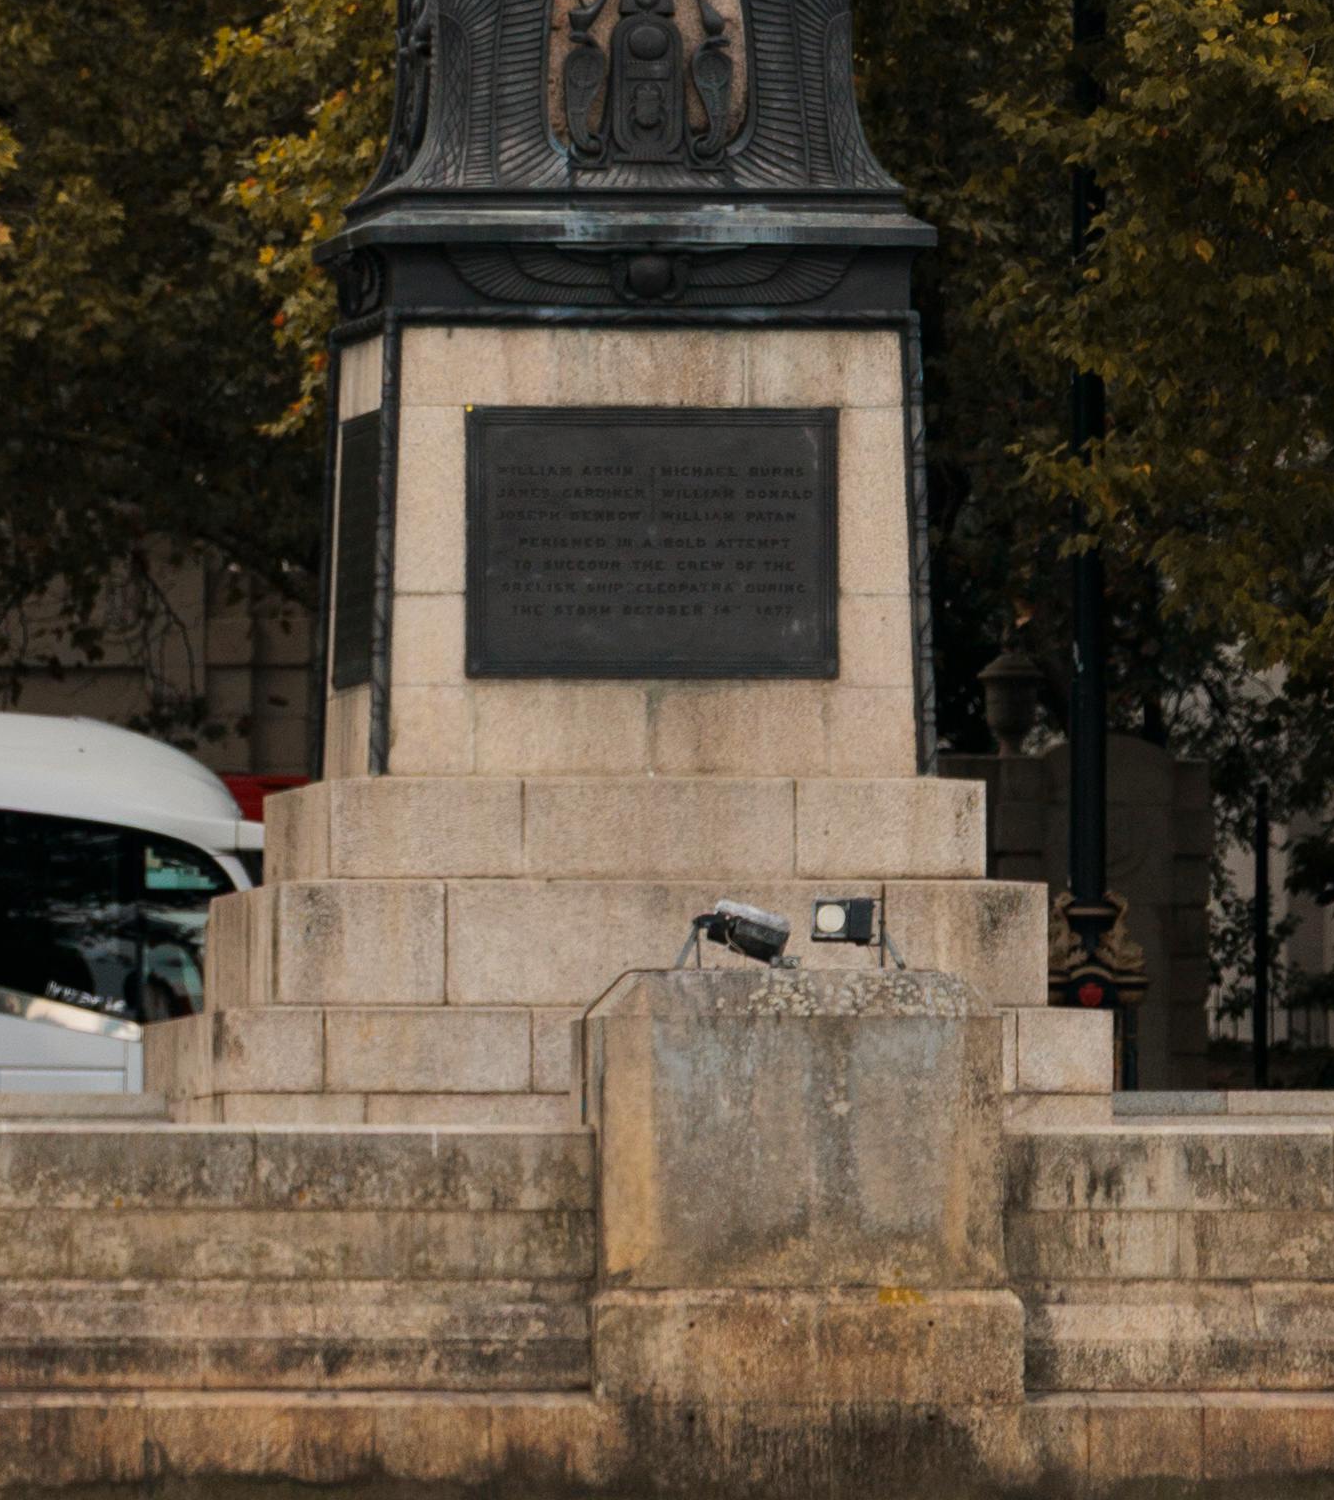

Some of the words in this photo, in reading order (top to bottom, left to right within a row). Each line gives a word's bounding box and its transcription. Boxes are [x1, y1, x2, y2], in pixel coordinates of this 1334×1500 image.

[498, 465, 572, 476] WILLIAM
[661, 466, 738, 477] MICHAEL
[749, 466, 804, 477] BURNS
[497, 488, 549, 498] JAMES
[662, 489, 734, 499] WILLIAM
[746, 489, 813, 499] DONALD
[495, 510, 560, 521] JOSEPH
[661, 511, 734, 521] WILLIAM
[746, 511, 795, 521] PATAN
[519, 537, 606, 548] PERISHED
[616, 537, 632, 547] IN
[643, 538, 652, 548] A
[664, 537, 706, 548] BOLD
[715, 538, 790, 548] ATTEMPT
[514, 560, 532, 571] TO
[544, 560, 620, 571] SUCCOUR
[632, 560, 665, 571] THE
[676, 560, 724, 571] CREW
[736, 560, 756, 571] OF
[763, 560, 795, 571] THE
[513, 605, 543, 616] THE
[555, 605, 610, 616] STORM
[623, 605, 702, 616] OCTOBER
